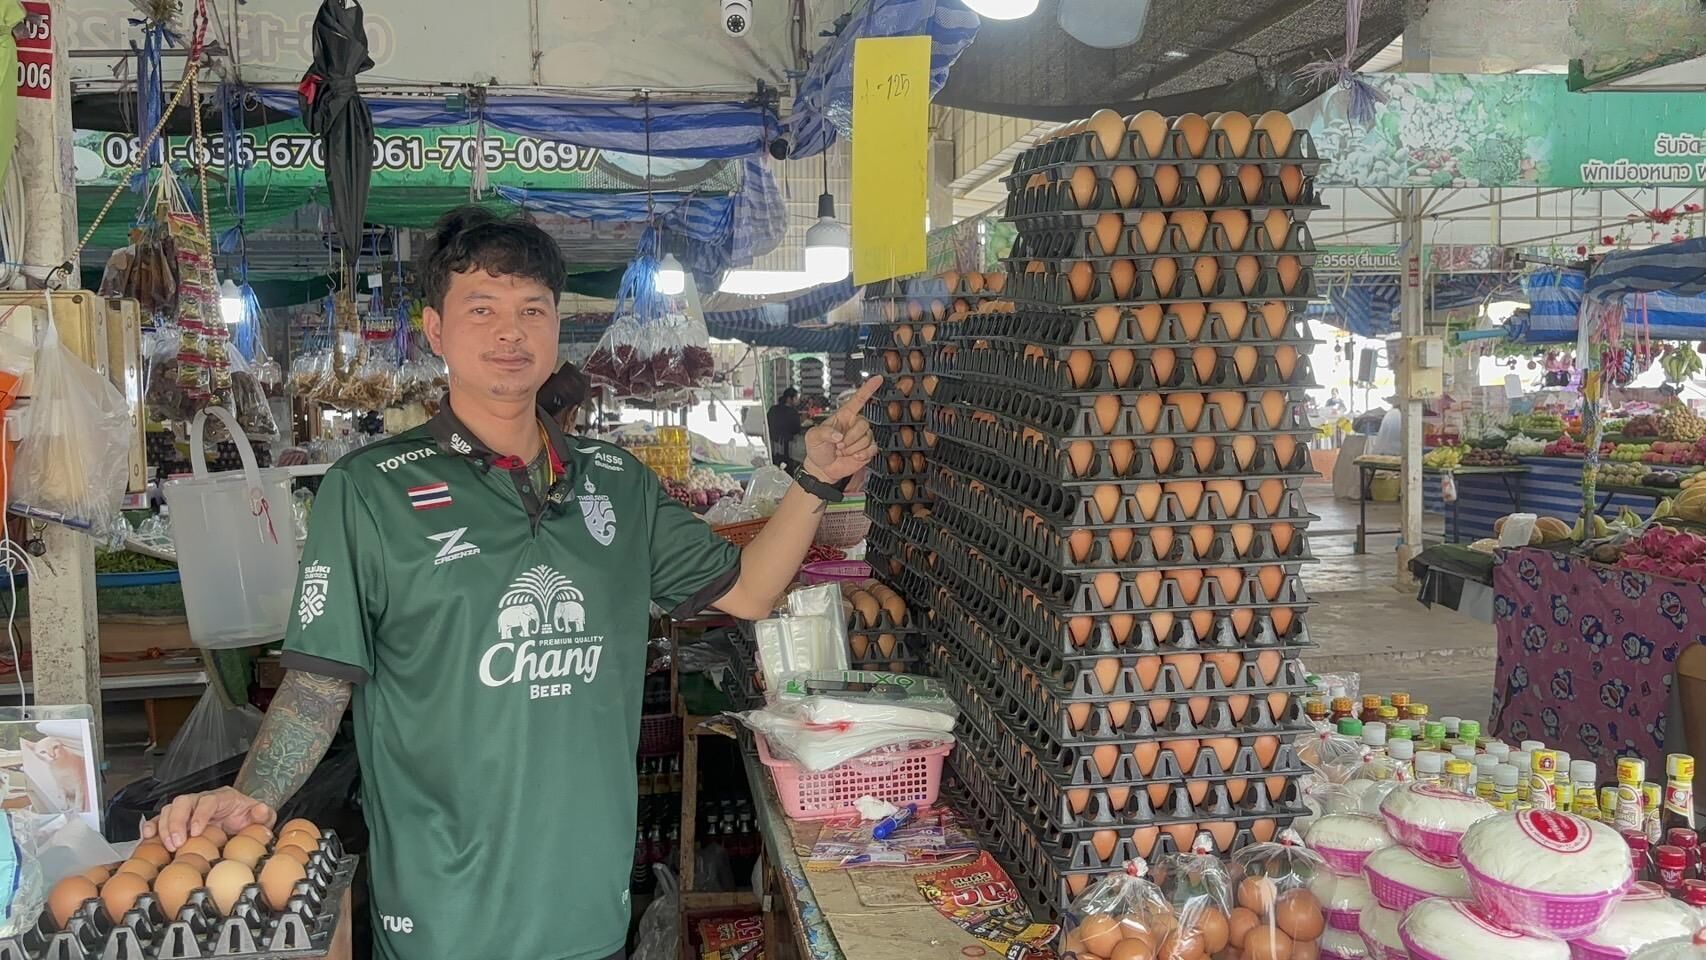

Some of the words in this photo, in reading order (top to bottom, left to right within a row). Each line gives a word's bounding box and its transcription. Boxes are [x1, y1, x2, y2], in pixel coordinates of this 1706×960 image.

[376, 447, 437, 473] TOYOTA
[538, 638, 572, 646] PREMIUM
[574, 636, 604, 644] QUALITY
[479, 639, 603, 687] Chang
[530, 683, 572, 700] BEER
[378, 910, 414, 934] rue
